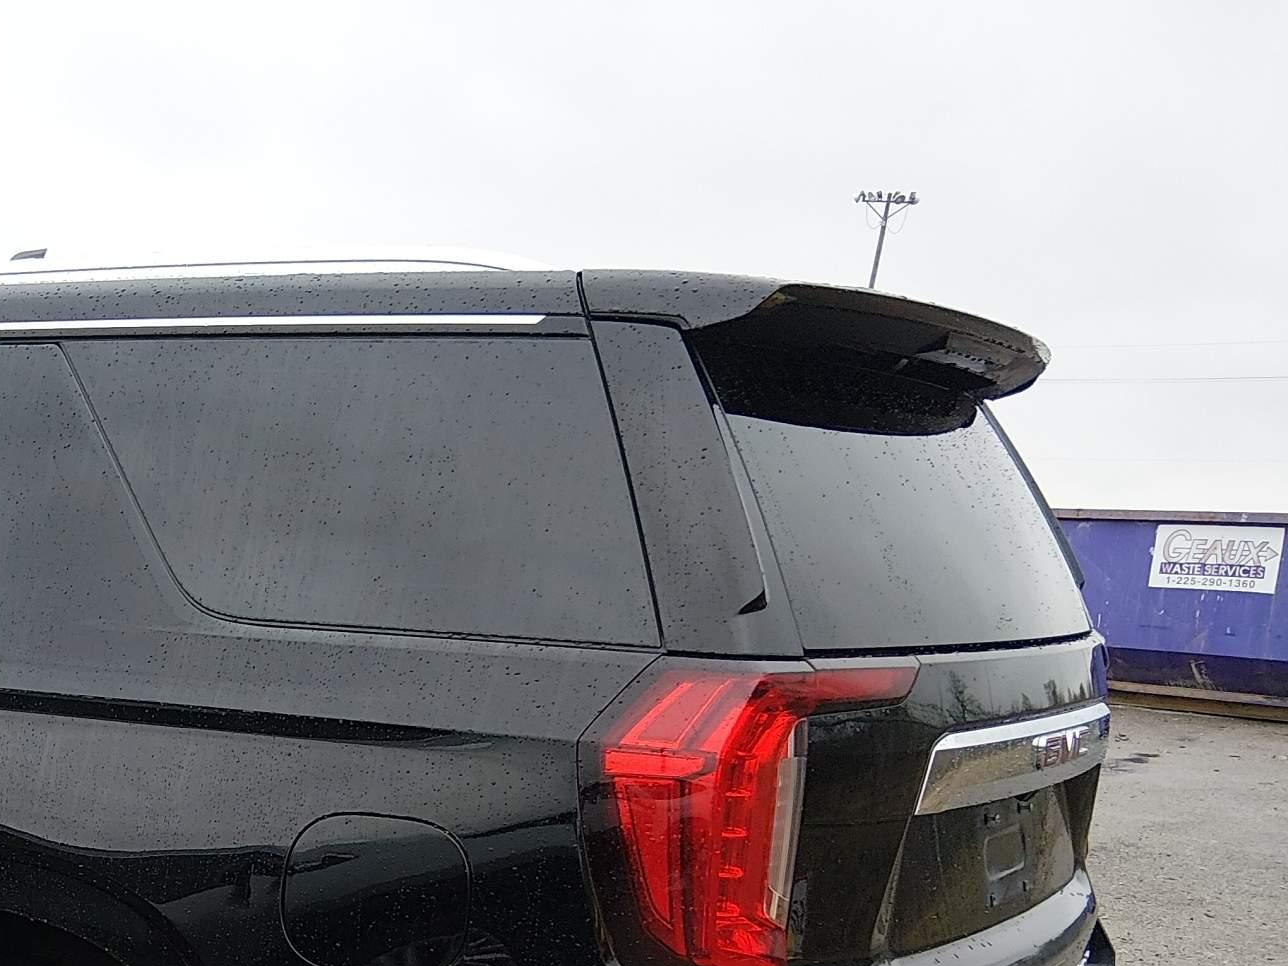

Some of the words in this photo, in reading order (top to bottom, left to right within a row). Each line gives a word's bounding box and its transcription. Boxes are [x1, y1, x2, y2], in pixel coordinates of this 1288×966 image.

[1163, 529, 1269, 565] GEAUX
[1161, 563, 1202, 575] WASTE
[1204, 565, 1265, 578] SERVICES
[1166, 576, 1256, 589] 1-225-290-1360
